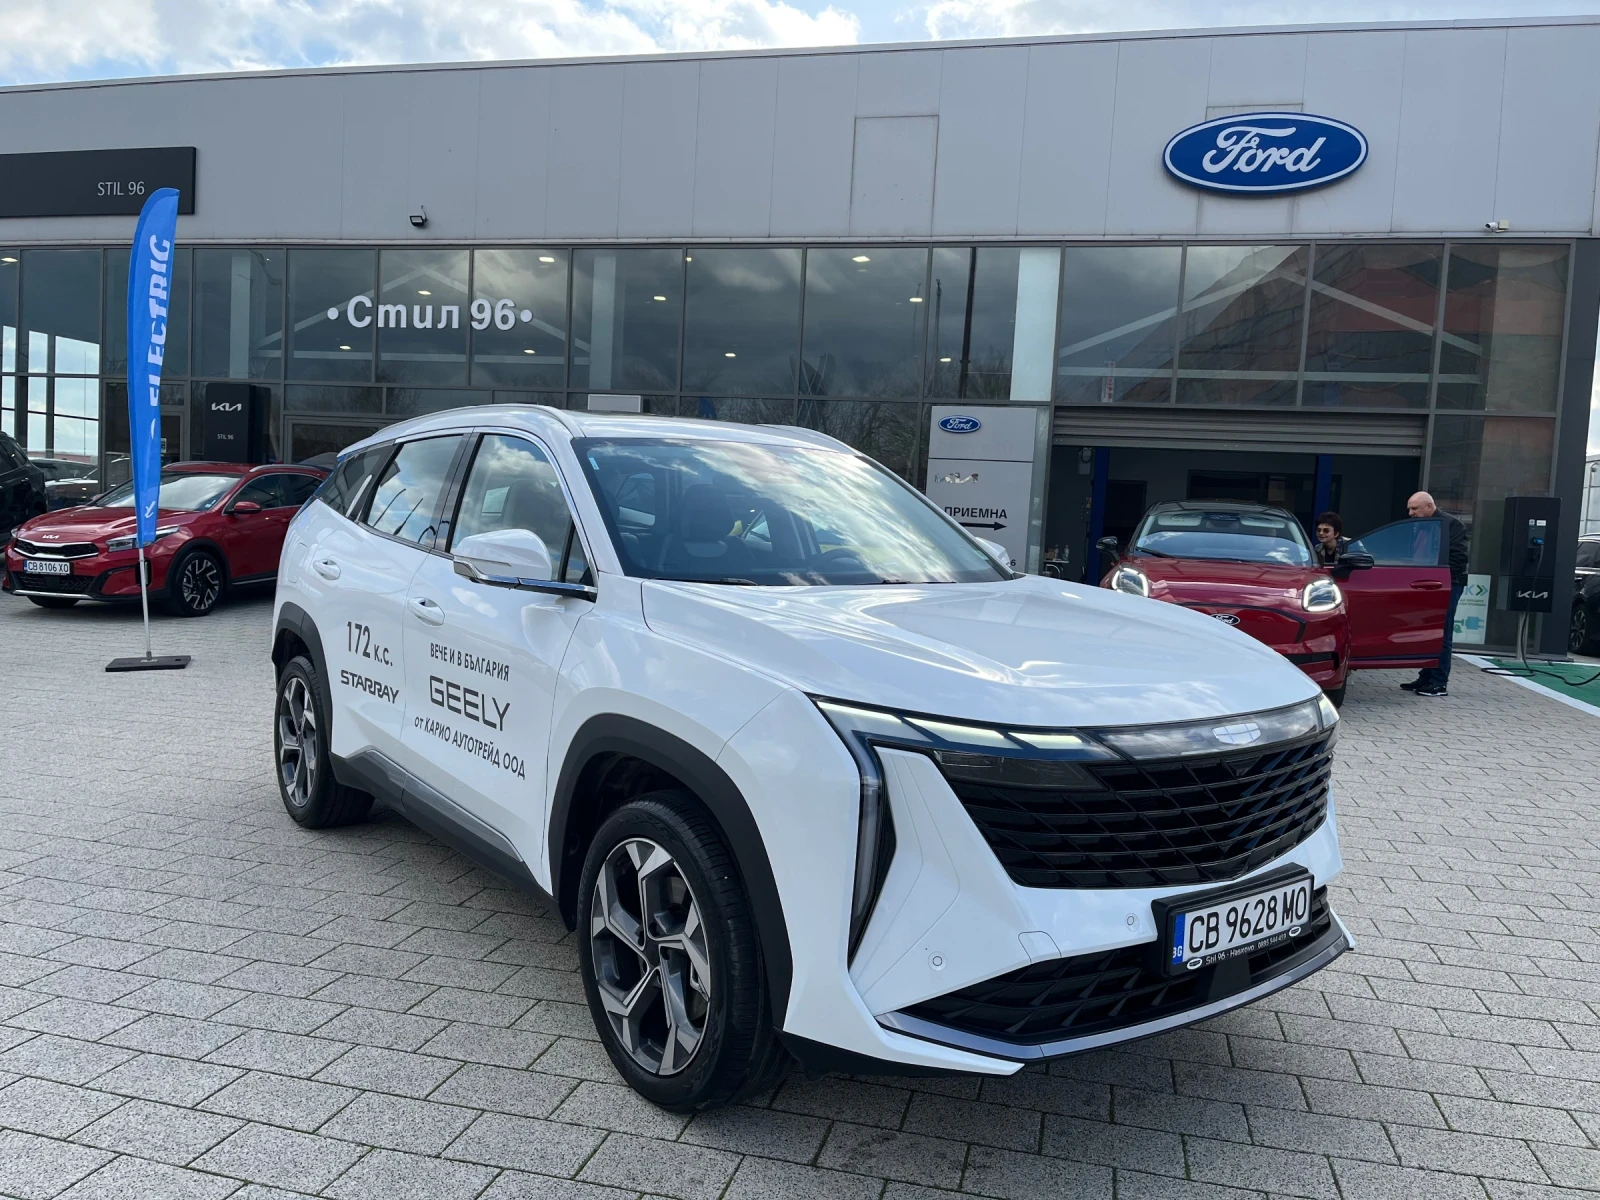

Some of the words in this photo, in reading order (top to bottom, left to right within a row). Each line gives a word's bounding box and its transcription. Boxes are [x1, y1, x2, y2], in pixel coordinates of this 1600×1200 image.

[1202, 126, 1327, 174] Ford
[97, 181, 125, 196] STIL
[128, 181, 145, 195] 96
[470, 298, 516, 331] 96
[211, 402, 242, 411] KIA
[946, 418, 972, 430] Ford
[944, 506, 1008, 519] ПРИЕМНА
[28, 562, 38, 571] CB
[39, 563, 57, 572] 8106
[1516, 590, 1548, 599] KIA
[347, 621, 371, 659] 172
[430, 642, 448, 662] ВЕЧЕ
[449, 648, 455, 665] И
[457, 650, 462, 667] В
[464, 652, 510, 682] БЪЛГАРИЯ
[340, 669, 400, 704] STARRAY
[429, 674, 511, 732] GEELY
[414, 716, 424, 730] от
[424, 717, 451, 742] КАРИО
[452, 730, 500, 769] АУТОТРЕЙД
[503, 752, 526, 780] ООД
[1188, 911, 1220, 953] CB
[1225, 895, 1278, 943] 9628
[1281, 886, 1307, 926] MO
[1205, 955, 1217, 965] Stil
[1217, 952, 1226, 960] 96
[1229, 945, 1255, 958] Haskovo
